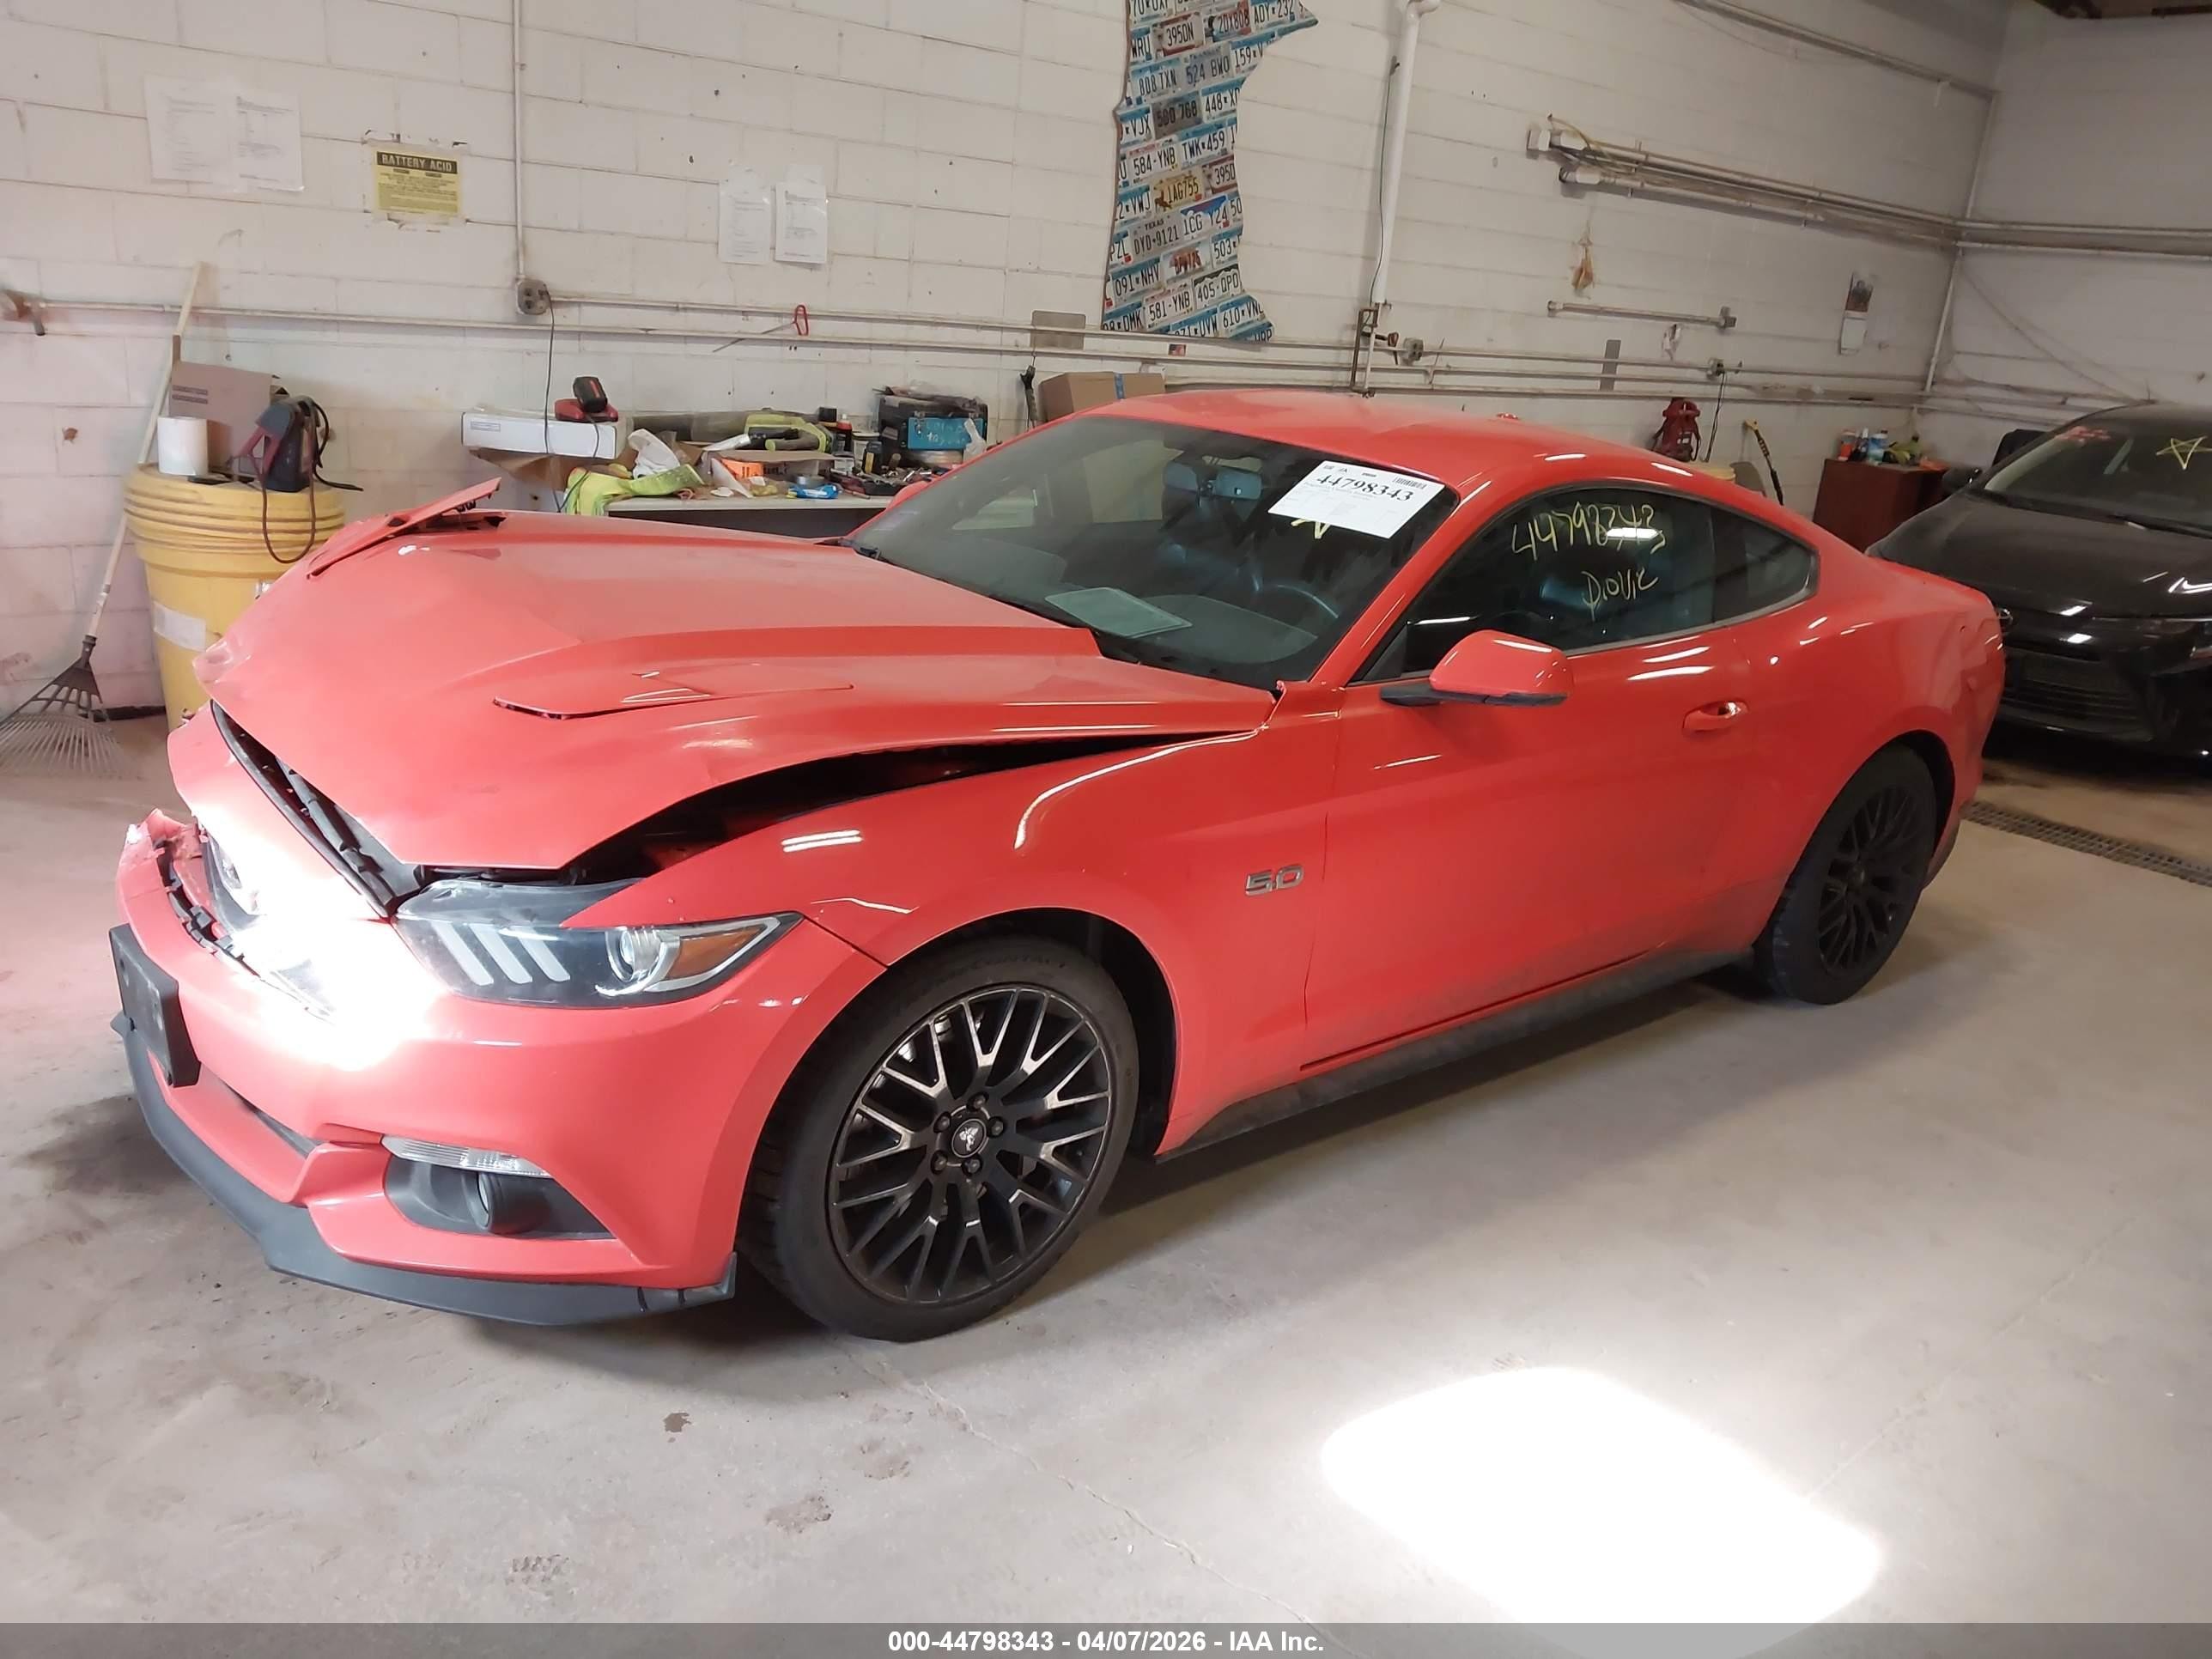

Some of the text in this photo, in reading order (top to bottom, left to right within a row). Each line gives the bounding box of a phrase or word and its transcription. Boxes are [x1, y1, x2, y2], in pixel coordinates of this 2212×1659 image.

[381, 155, 453, 173] BATTERY ACID
[1145, 219, 1164, 230] TEXAS
[1316, 474, 1414, 501] 44798343
[1245, 865, 1304, 896] 5.0
